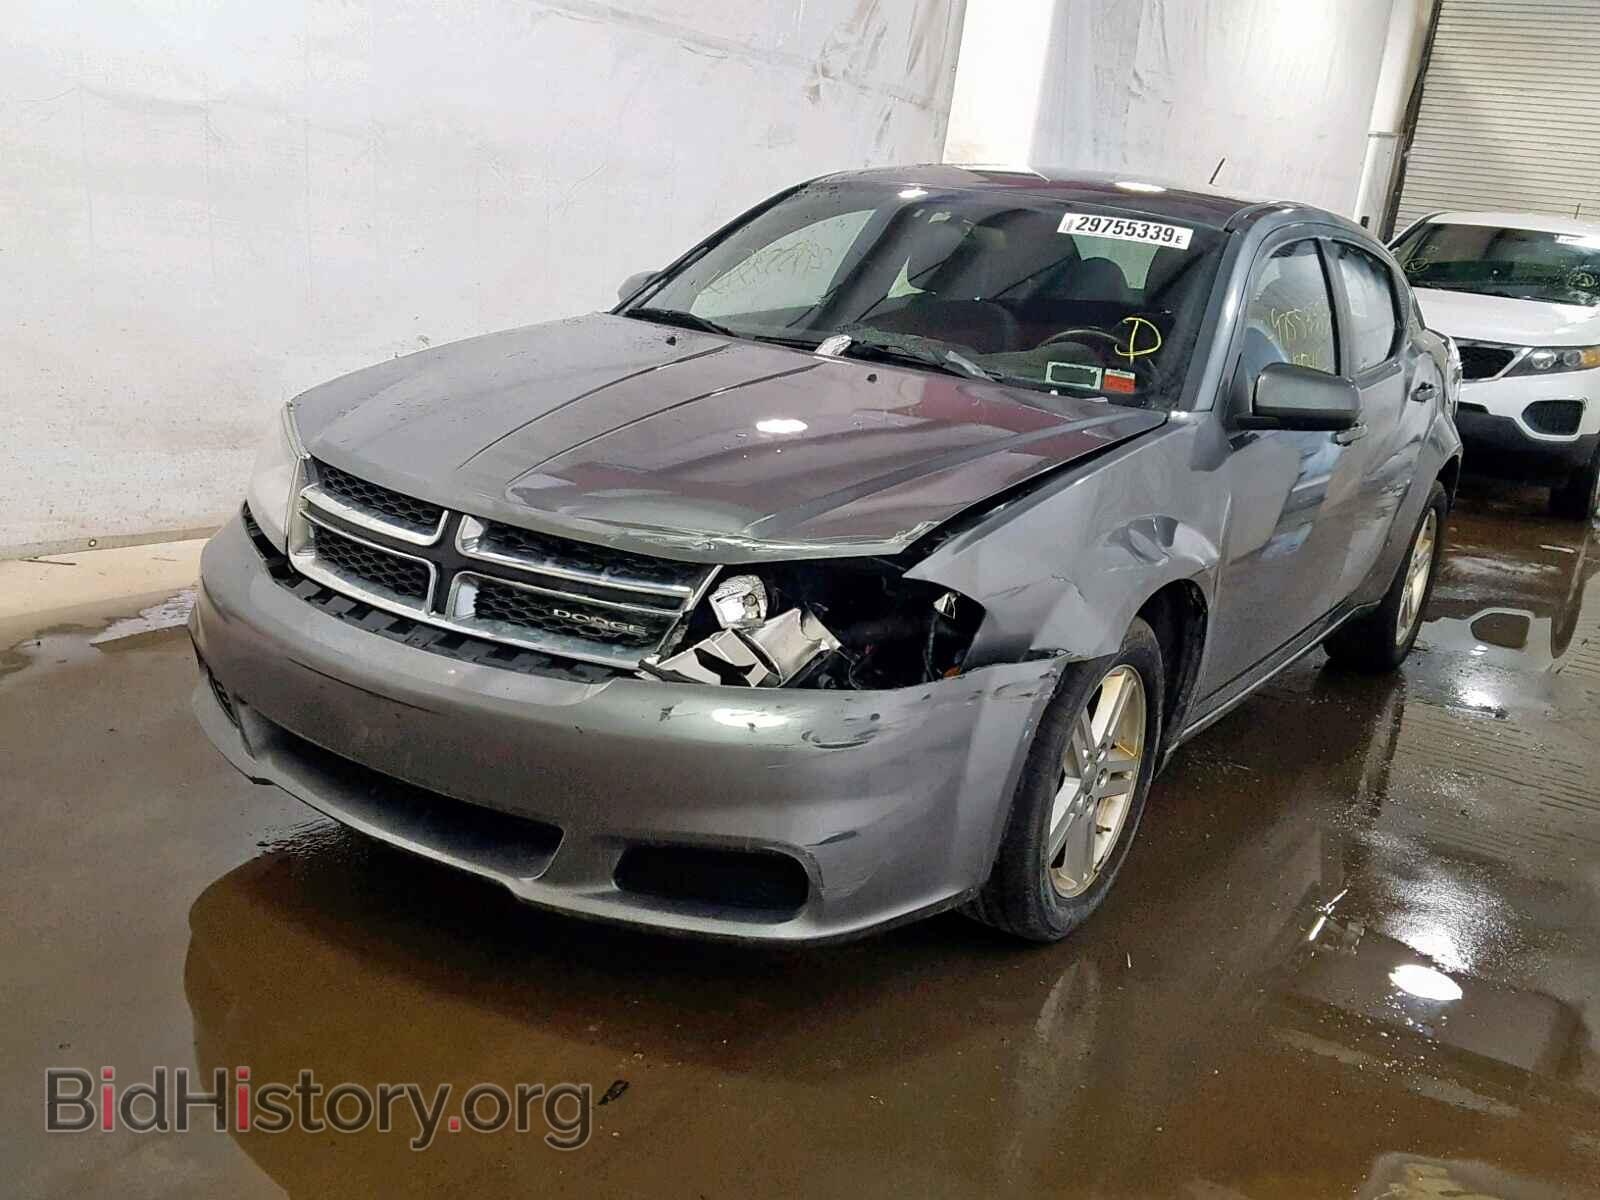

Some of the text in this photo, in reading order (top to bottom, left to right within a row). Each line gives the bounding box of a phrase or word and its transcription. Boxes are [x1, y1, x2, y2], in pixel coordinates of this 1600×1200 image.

[1075, 216, 1175, 243] 29755339
[1114, 317, 1161, 368] D
[553, 609, 647, 634] DODGE
